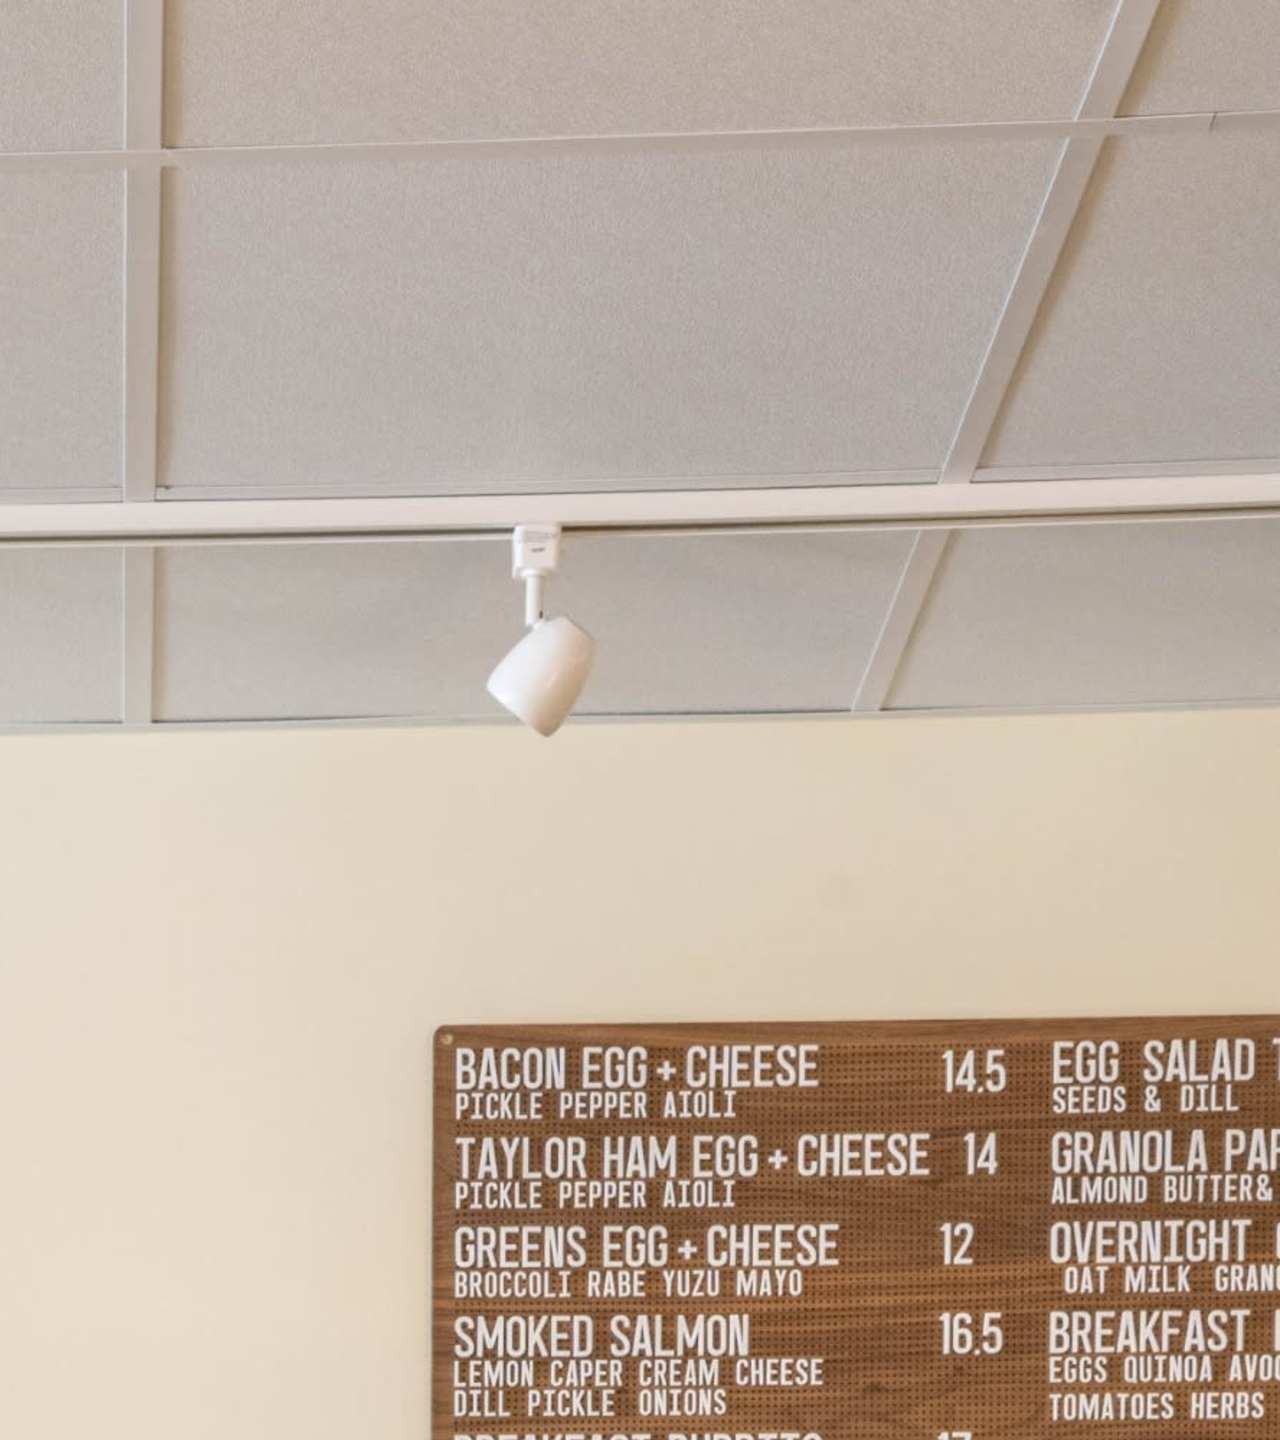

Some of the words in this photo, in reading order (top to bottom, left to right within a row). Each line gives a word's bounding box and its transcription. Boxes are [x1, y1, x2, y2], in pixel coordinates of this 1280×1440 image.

[455, 1092, 543, 1120] PICKLE
[559, 1091, 647, 1119] PEPPER
[663, 1090, 736, 1118] AIOLI
[454, 1270, 571, 1298] BROCCOLI
[587, 1270, 646, 1298] RABE
[663, 1269, 720, 1297] YUZU
[736, 1269, 802, 1297] MAYO
[454, 1315, 593, 1358] SMOKED
[610, 1313, 749, 1357] SALMON
[939, 1311, 1003, 1355] 16.5
[453, 1359, 534, 1388] LEMON
[550, 1359, 623, 1387] CAPER
[639, 1358, 719, 1387] CREAM
[735, 1358, 823, 1386] CHEESE
[1049, 1392, 1174, 1421] TOMATOES
[1190, 1391, 1264, 1419] HERBS
